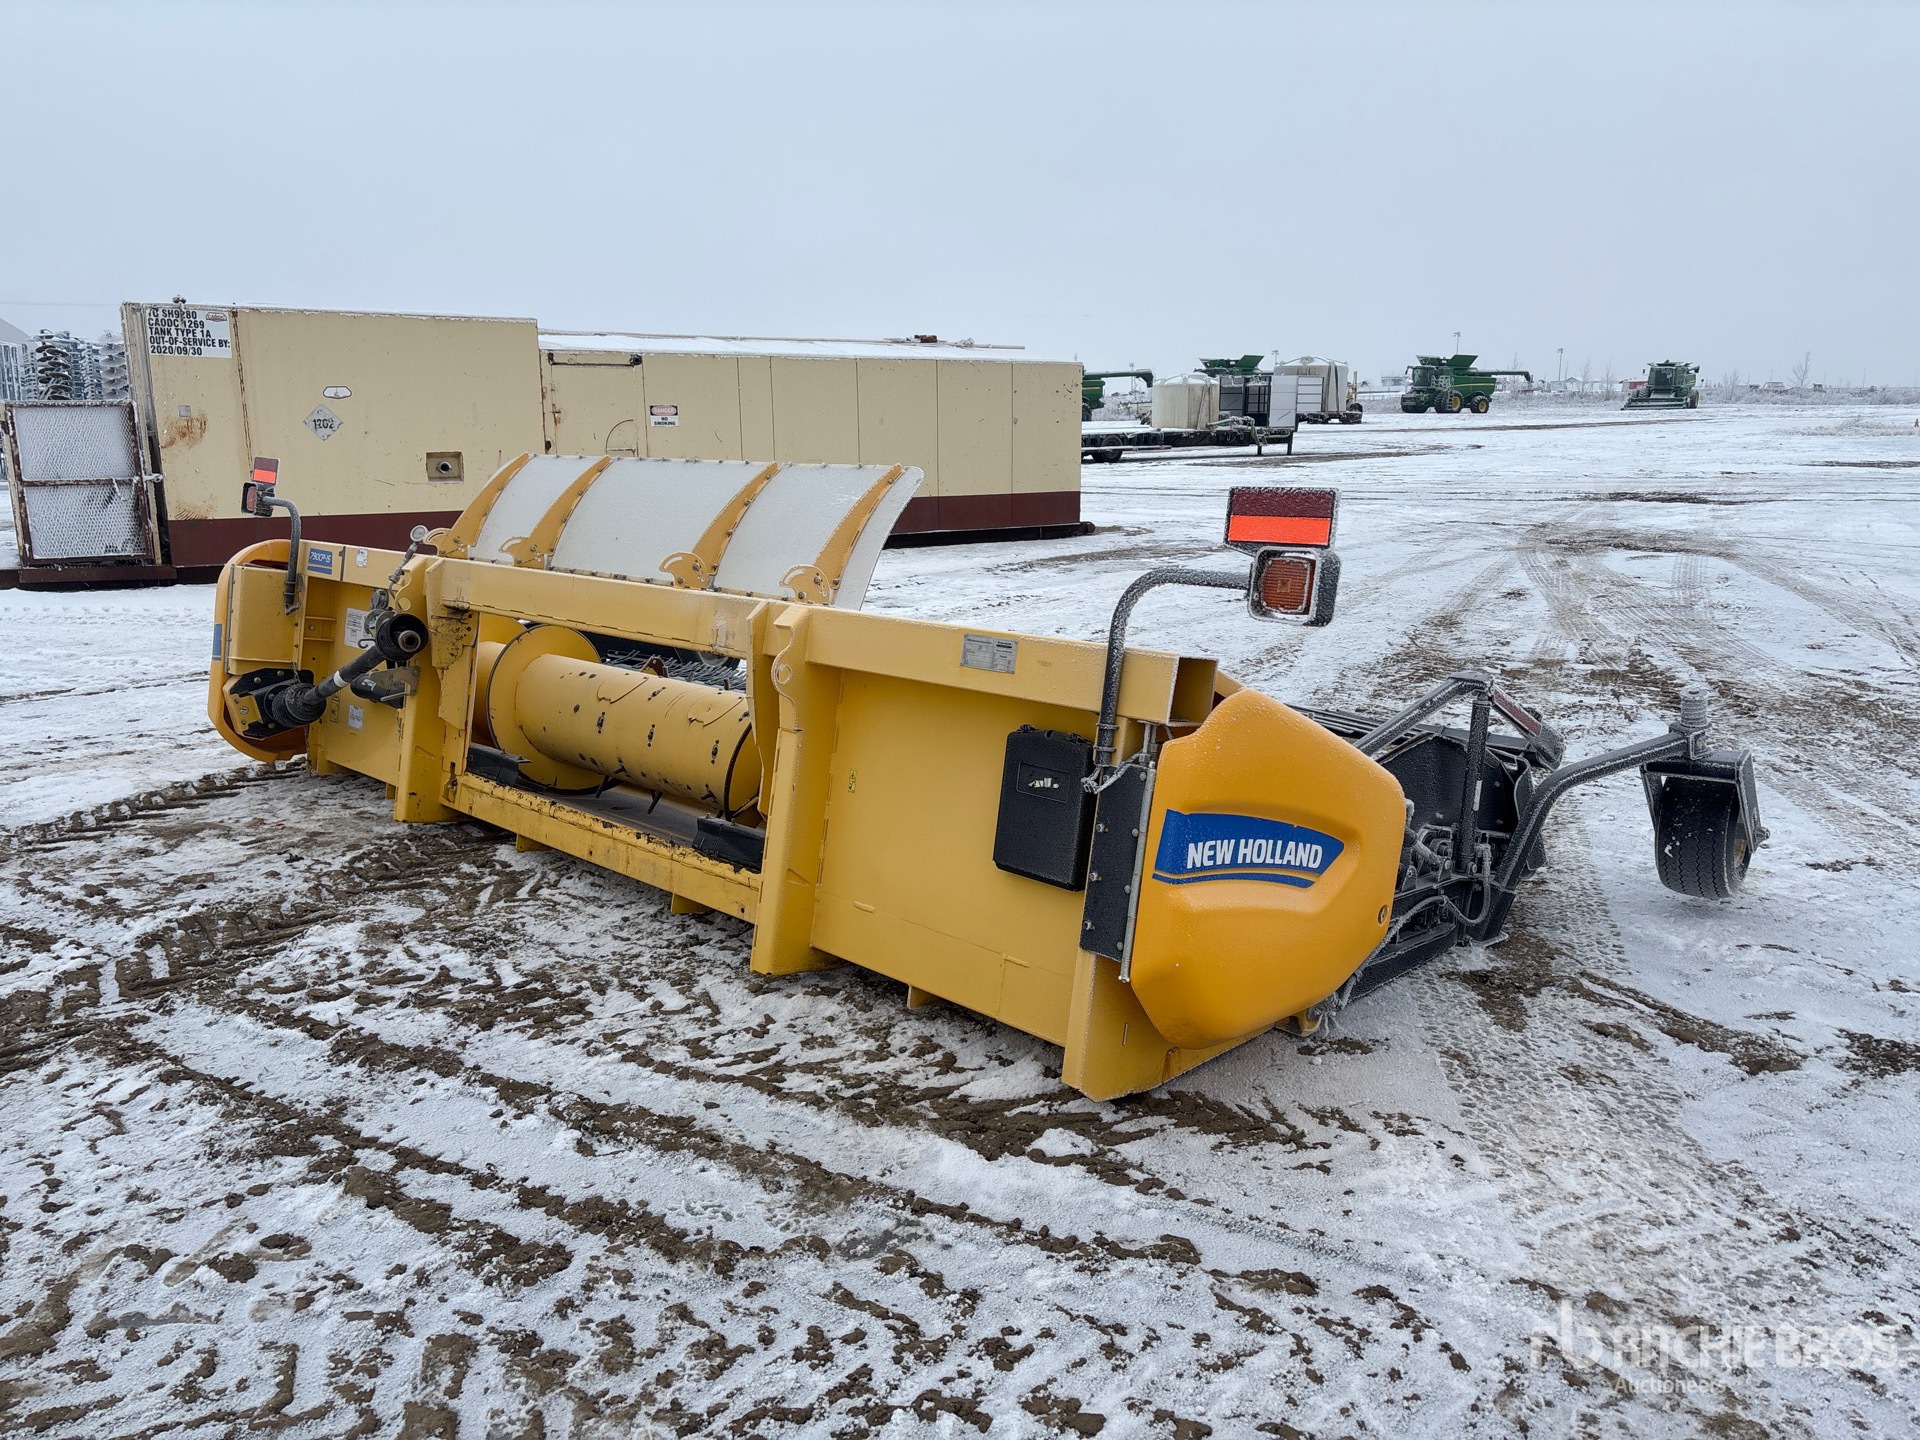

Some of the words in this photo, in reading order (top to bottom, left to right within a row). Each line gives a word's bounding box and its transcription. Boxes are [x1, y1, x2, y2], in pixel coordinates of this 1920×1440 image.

[148, 318, 179, 328] CAODC
[183, 320, 205, 329] 1269
[149, 327, 172, 336] TANK
[175, 328, 197, 337] TYPE
[200, 329, 211, 338] 1A
[149, 336, 216, 347] OUT-OF-SERVICE
[218, 339, 230, 348] BY:
[150, 345, 202, 356] 2020/09/30
[1187, 839, 1235, 869] NEW
[1237, 839, 1323, 869] HOLLAND
